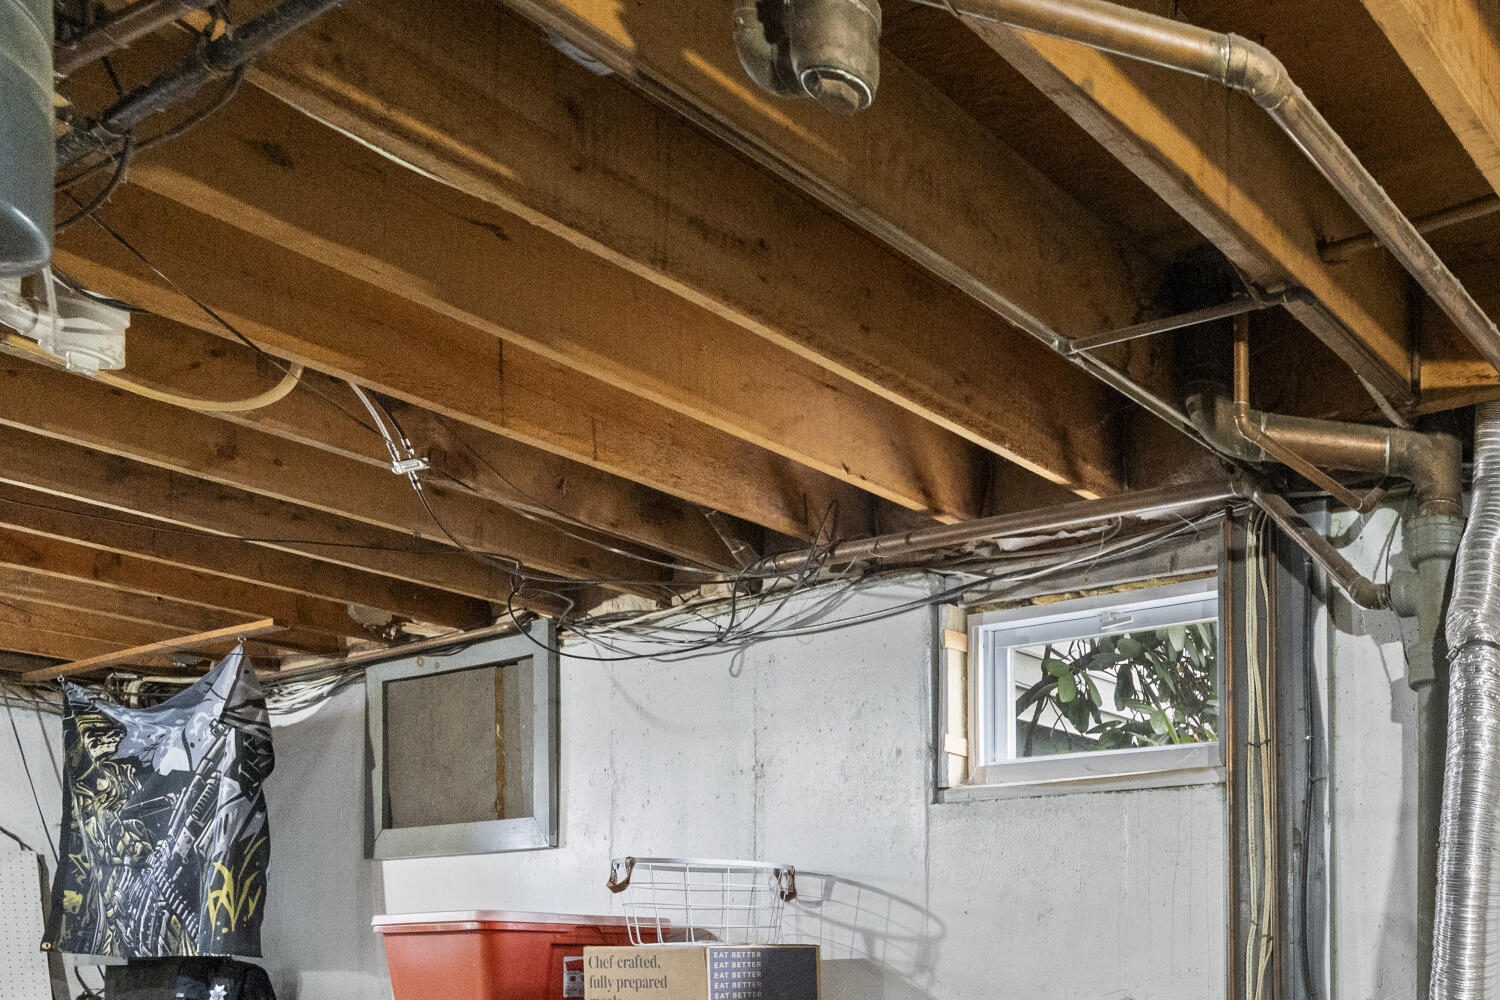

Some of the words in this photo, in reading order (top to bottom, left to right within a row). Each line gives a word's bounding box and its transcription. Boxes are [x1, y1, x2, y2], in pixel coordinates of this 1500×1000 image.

[588, 955, 615, 969] Chef
[589, 975, 612, 993] fully
[617, 975, 668, 992] prepared
[732, 981, 762, 989] BETTER
